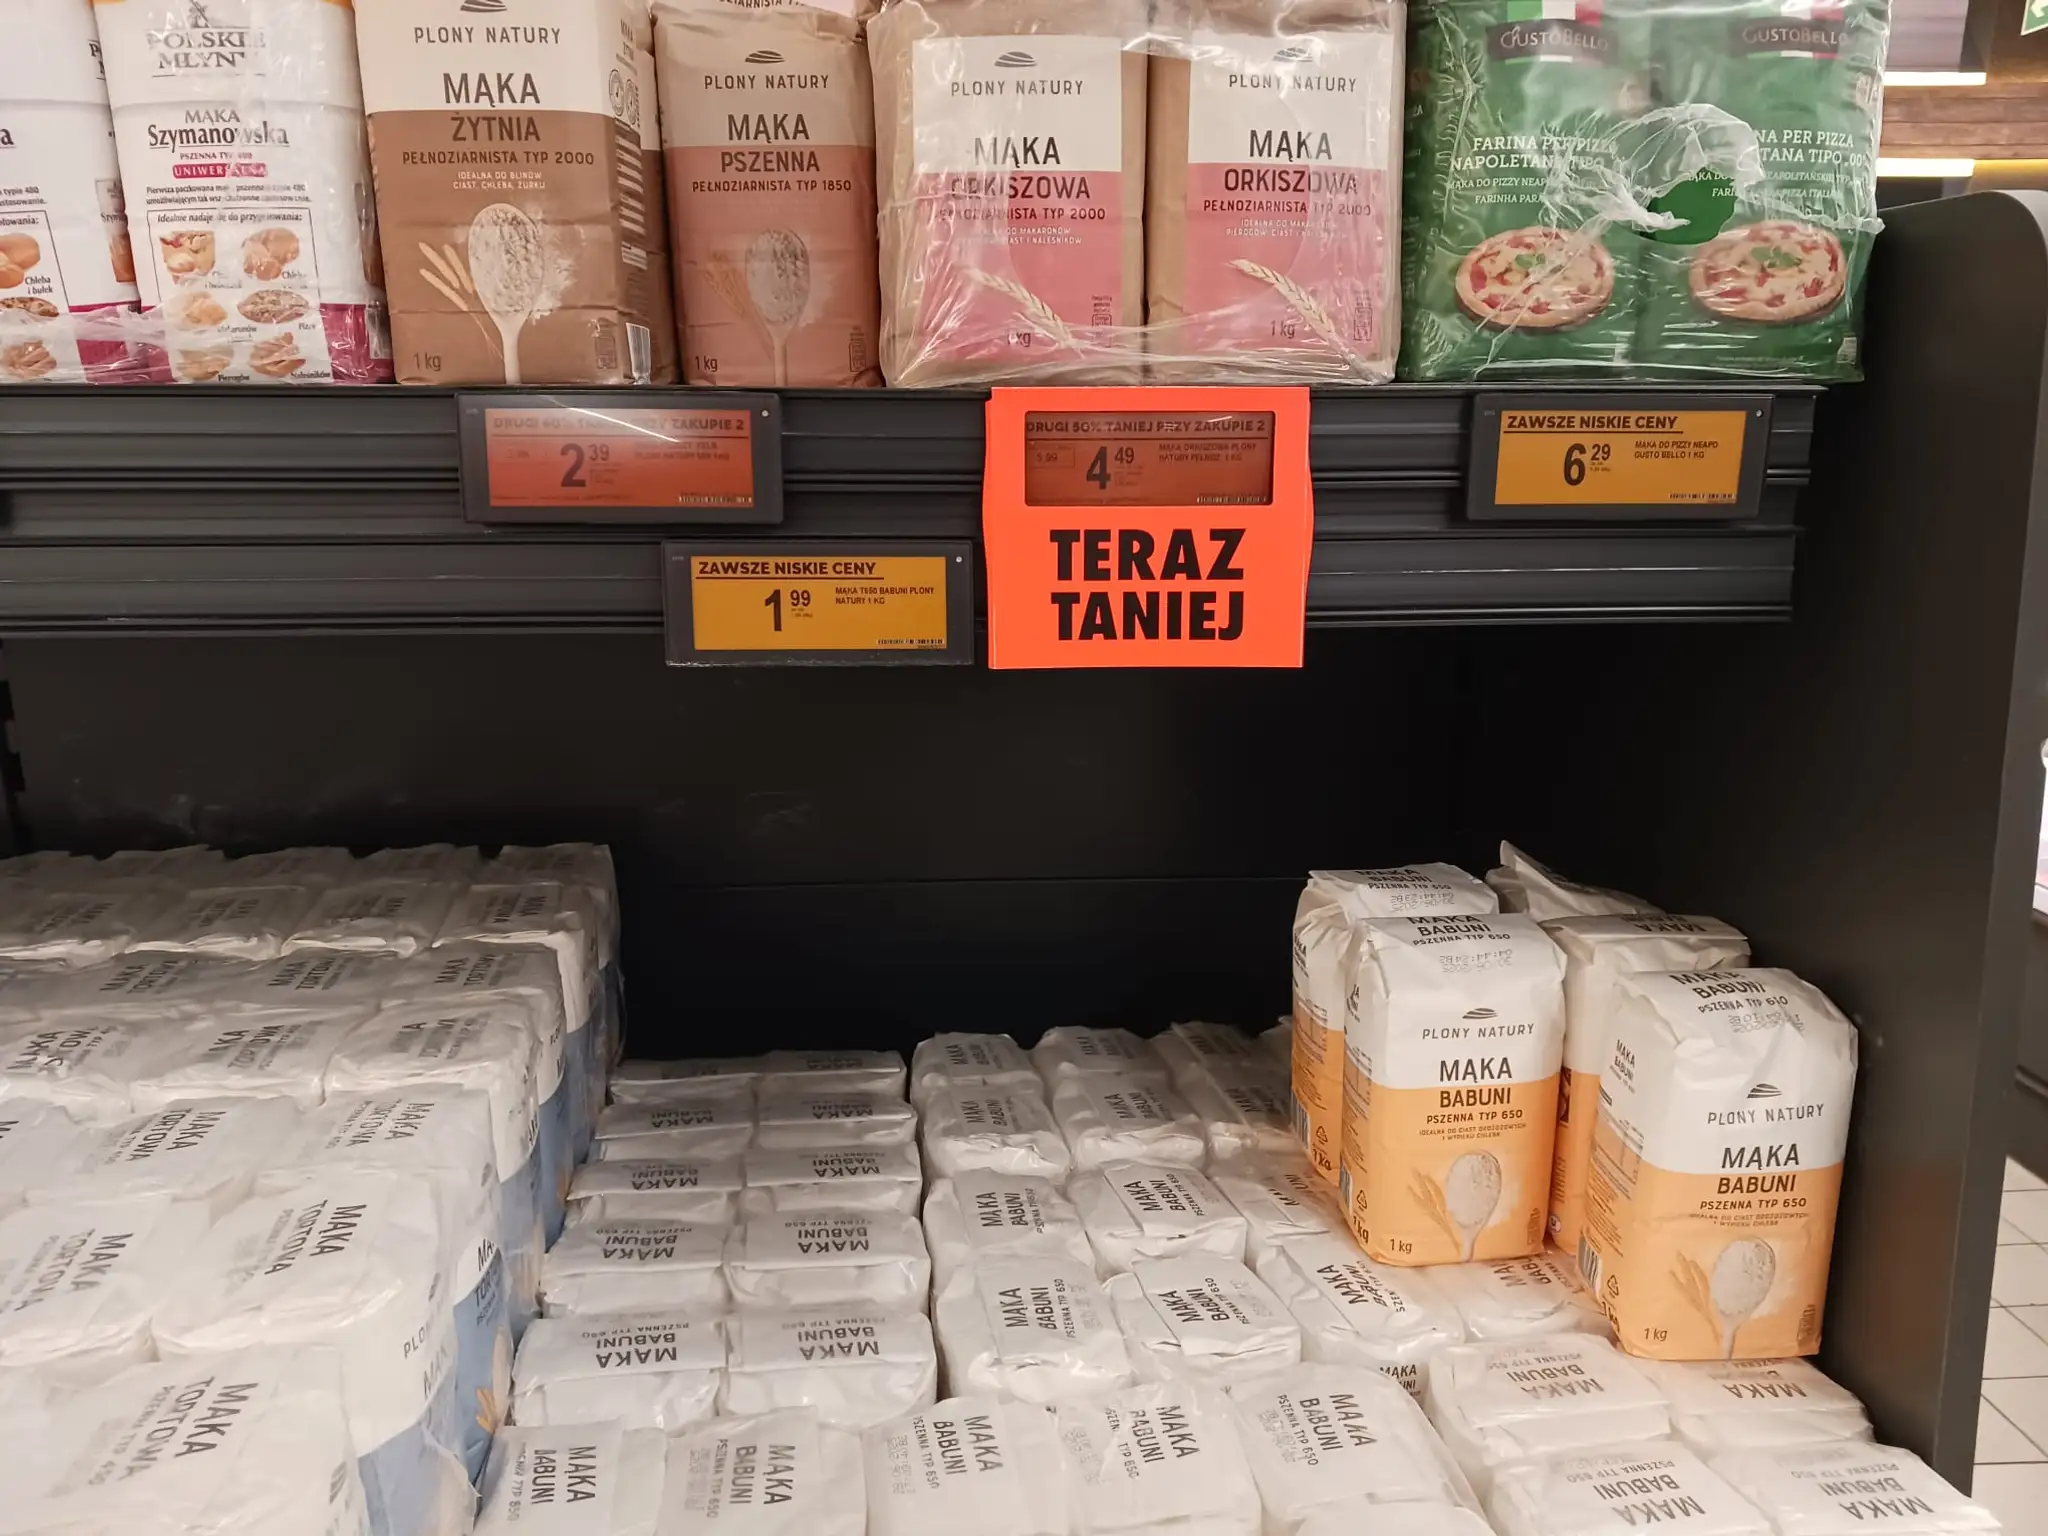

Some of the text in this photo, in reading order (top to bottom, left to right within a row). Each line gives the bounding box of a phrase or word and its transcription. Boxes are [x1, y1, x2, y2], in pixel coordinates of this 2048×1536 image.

[414, 26, 561, 45] PLONY NATURY
[443, 73, 541, 107] MĄKA
[704, 74, 829, 90] PLONY NATURY
[951, 80, 1084, 96] PLONY NATURY
[1229, 74, 1357, 92] PLONY NATURY
[185, 109, 240, 127] MĄKA
[451, 111, 541, 142] ŻYTNIA
[727, 113, 810, 143] MĄKA
[1249, 129, 1333, 162] MĄKA
[1473, 135, 1538, 152] FARINA
[1782, 129, 1854, 148] PER PIZZA
[402, 151, 594, 165] PEŁNOZIARNISTA TYP 2000
[974, 136, 1061, 168] MĄKA
[1809, 149, 1842, 164] TIPO
[721, 150, 820, 173] PSZENNA
[458, 171, 491, 180] IDEALNA
[495, 171, 506, 179] DO
[1224, 168, 1359, 195] ORKISZOWA
[1476, 178, 1490, 188] DO
[1492, 177, 1519, 188] PIZZY
[692, 180, 852, 192] PEŁNOZIARNISTA TYP 1850
[1203, 199, 1307, 213] PEŁNOZIARNISTA
[1475, 194, 1516, 204] FARINHA
[157, 212, 238, 224] Idealnie nadaje do
[1044, 208, 1106, 220] TYP 2000
[25, 276, 51, 286] Chleba
[33, 285, 53, 296] bułek
[1280, 320, 1296, 339] kg
[424, 352, 441, 372] kg
[703, 355, 718, 372] kg
[672, 419, 744, 431] ZAKUPIE 2
[1027, 420, 1265, 433] DRUGI TANIEJ PRZY ZAKUPIE 2
[1507, 415, 1678, 429] ZAWSZE NISKIE CENY
[588, 444, 610, 462] 39
[1590, 444, 1611, 461] 29
[1658, 441, 1670, 449] DO
[1671, 441, 1692, 449] PIZZY
[1693, 441, 1718, 449] NEAPO
[1114, 447, 1135, 464] 49
[1634, 451, 1660, 459] GUSTO
[1662, 451, 1686, 459] BELLO
[560, 443, 586, 488] 2
[1086, 446, 1111, 490] 4
[1563, 443, 1587, 486] 6
[1050, 528, 1246, 581] TERAZ
[699, 562, 876, 575] ZAWSZE NISKIE CENY
[790, 590, 811, 607] 99
[879, 587, 908, 595] BABUNI
[910, 587, 934, 595] PLONY
[835, 597, 885, 605] NATURY KG
[765, 589, 782, 632] 1
[1051, 591, 1244, 641] TANIEJ
[1368, 882, 1409, 890] PSZENNA
[1417, 923, 1491, 937] BABUNI
[1413, 933, 1511, 946] PSZENNA TYP 650
[1692, 980, 1766, 999] BABUNI
[1422, 1023, 1535, 1040] PLONY NATURY
[1439, 1057, 1513, 1084] MĄKA
[1439, 1087, 1511, 1109] BABUNI
[1426, 1109, 1523, 1124] PSZENNA TYP 650
[1707, 1103, 1824, 1125] PLONY NATURY
[125, 1107, 193, 1162] TORTOWA
[813, 1158, 876, 1167] BABUNI
[1721, 1143, 1800, 1170] MĄKA
[1717, 1174, 1796, 1195] BABUNI
[1149, 1180, 1186, 1211] BABUNI
[1004, 1192, 1029, 1226] BABUNI
[1700, 1198, 1807, 1211] PSZENNA TYP 650
[264, 1199, 328, 1275] TORTOWA
[605, 1234, 677, 1246] BABUNI
[797, 1227, 868, 1240] BABUNI
[1399, 1239, 1412, 1254] kg
[1204, 1277, 1220, 1293] 650
[998, 1287, 1029, 1328] MĄKA
[1030, 1287, 1058, 1330] BABUNI
[1186, 1288, 1230, 1322] BABUNI
[637, 1322, 689, 1332] PSZENNA
[797, 1326, 875, 1342] BABUNI
[1653, 1328, 1668, 1342] kg
[596, 1333, 676, 1349] BABUNI
[1506, 1363, 1585, 1383] BABUNI
[117, 1376, 215, 1482] TORTOWA
[1299, 1398, 1344, 1451] BABUNI
[1129, 1409, 1166, 1463] BABUNI
[933, 1421, 968, 1475] BABUNI
[1118, 1442, 1132, 1458] TYP
[1302, 1447, 1319, 1466] 650
[567, 1445, 597, 1503] MĄKA
[729, 1445, 758, 1505] BABUNI
[763, 1444, 796, 1505] MĄKA
[1604, 1467, 1626, 1478] TYP
[1631, 1460, 1675, 1476] PSZENNA
[1855, 1463, 1900, 1476] PSZENNA
[1593, 1474, 1681, 1501] BABUNI
[1818, 1476, 1907, 1497] BABUNI
[706, 1500, 721, 1519] 650
